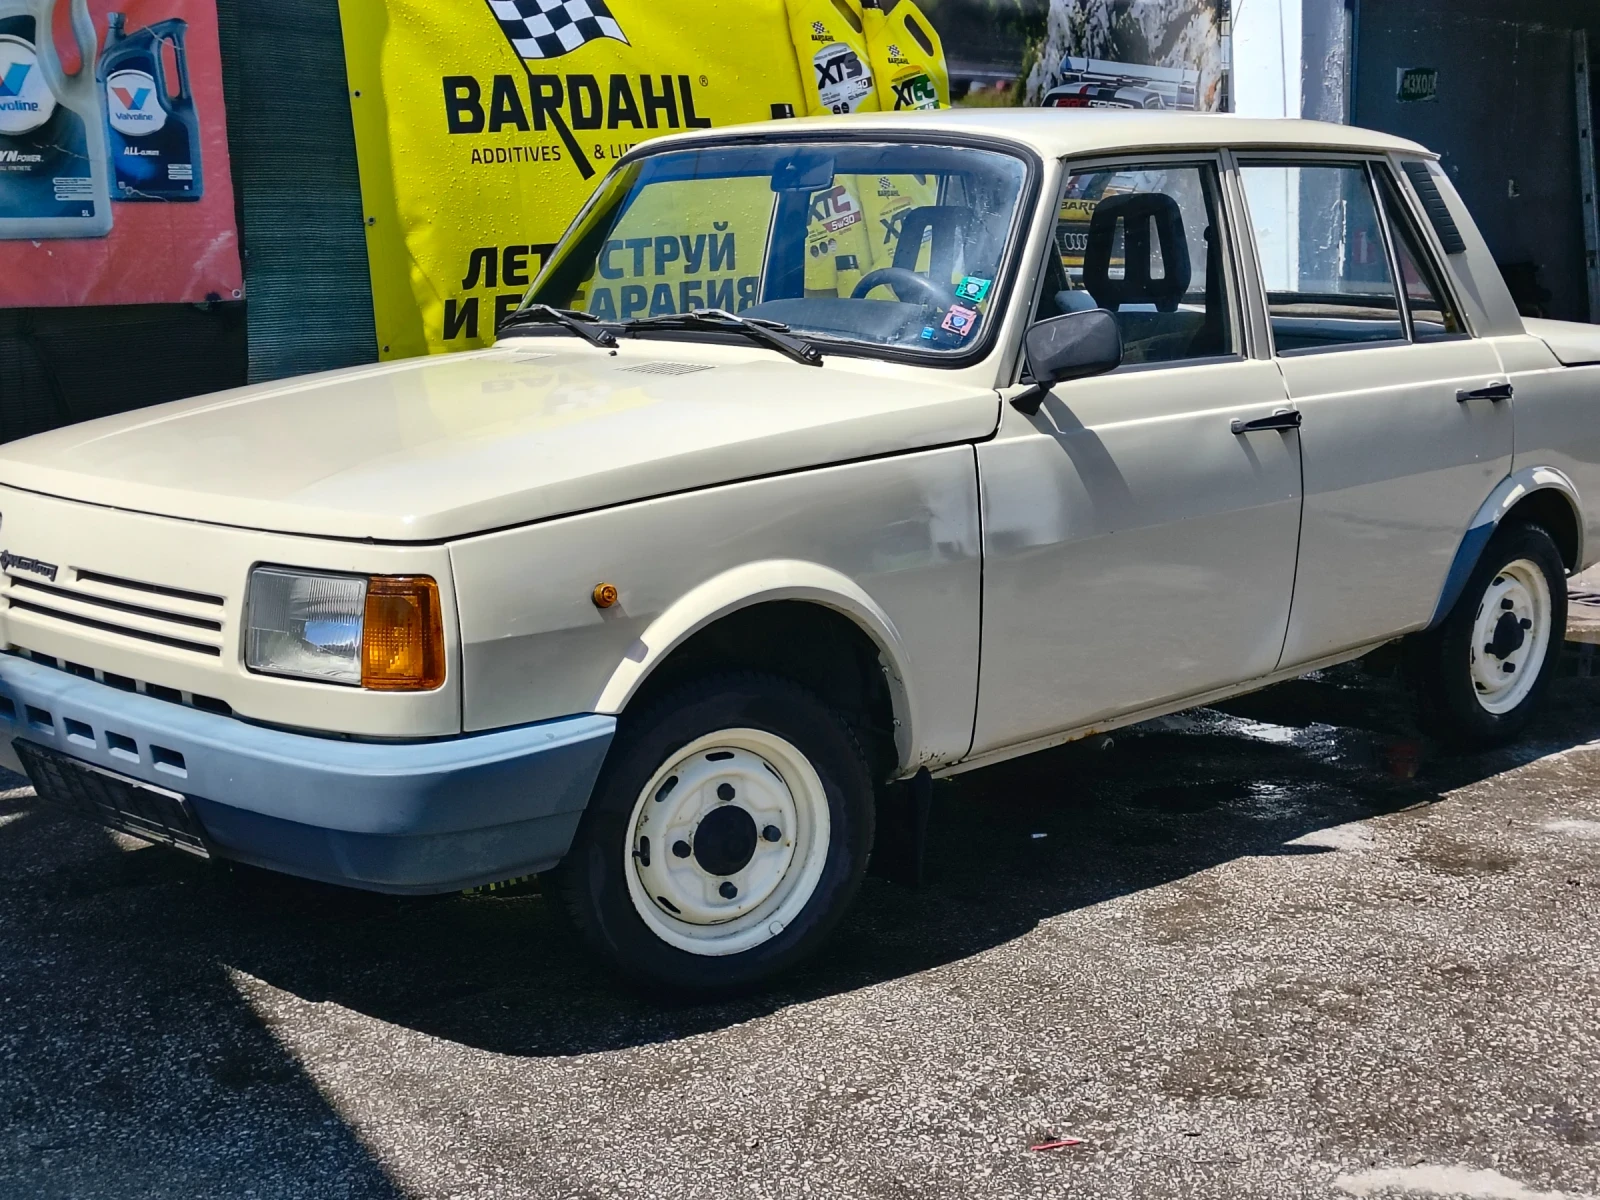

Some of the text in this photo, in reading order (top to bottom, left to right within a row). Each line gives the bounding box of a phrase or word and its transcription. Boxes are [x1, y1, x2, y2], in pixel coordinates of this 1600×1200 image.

[814, 50, 863, 91] XTS
[115, 112, 153, 121] Valvoline
[442, 74, 712, 180] BARDAHL
[471, 145, 561, 164] ADDITIVES
[593, 144, 606, 159] &
[462, 221, 736, 290] ЛЕТСТРУЙ
[443, 297, 479, 341] И
